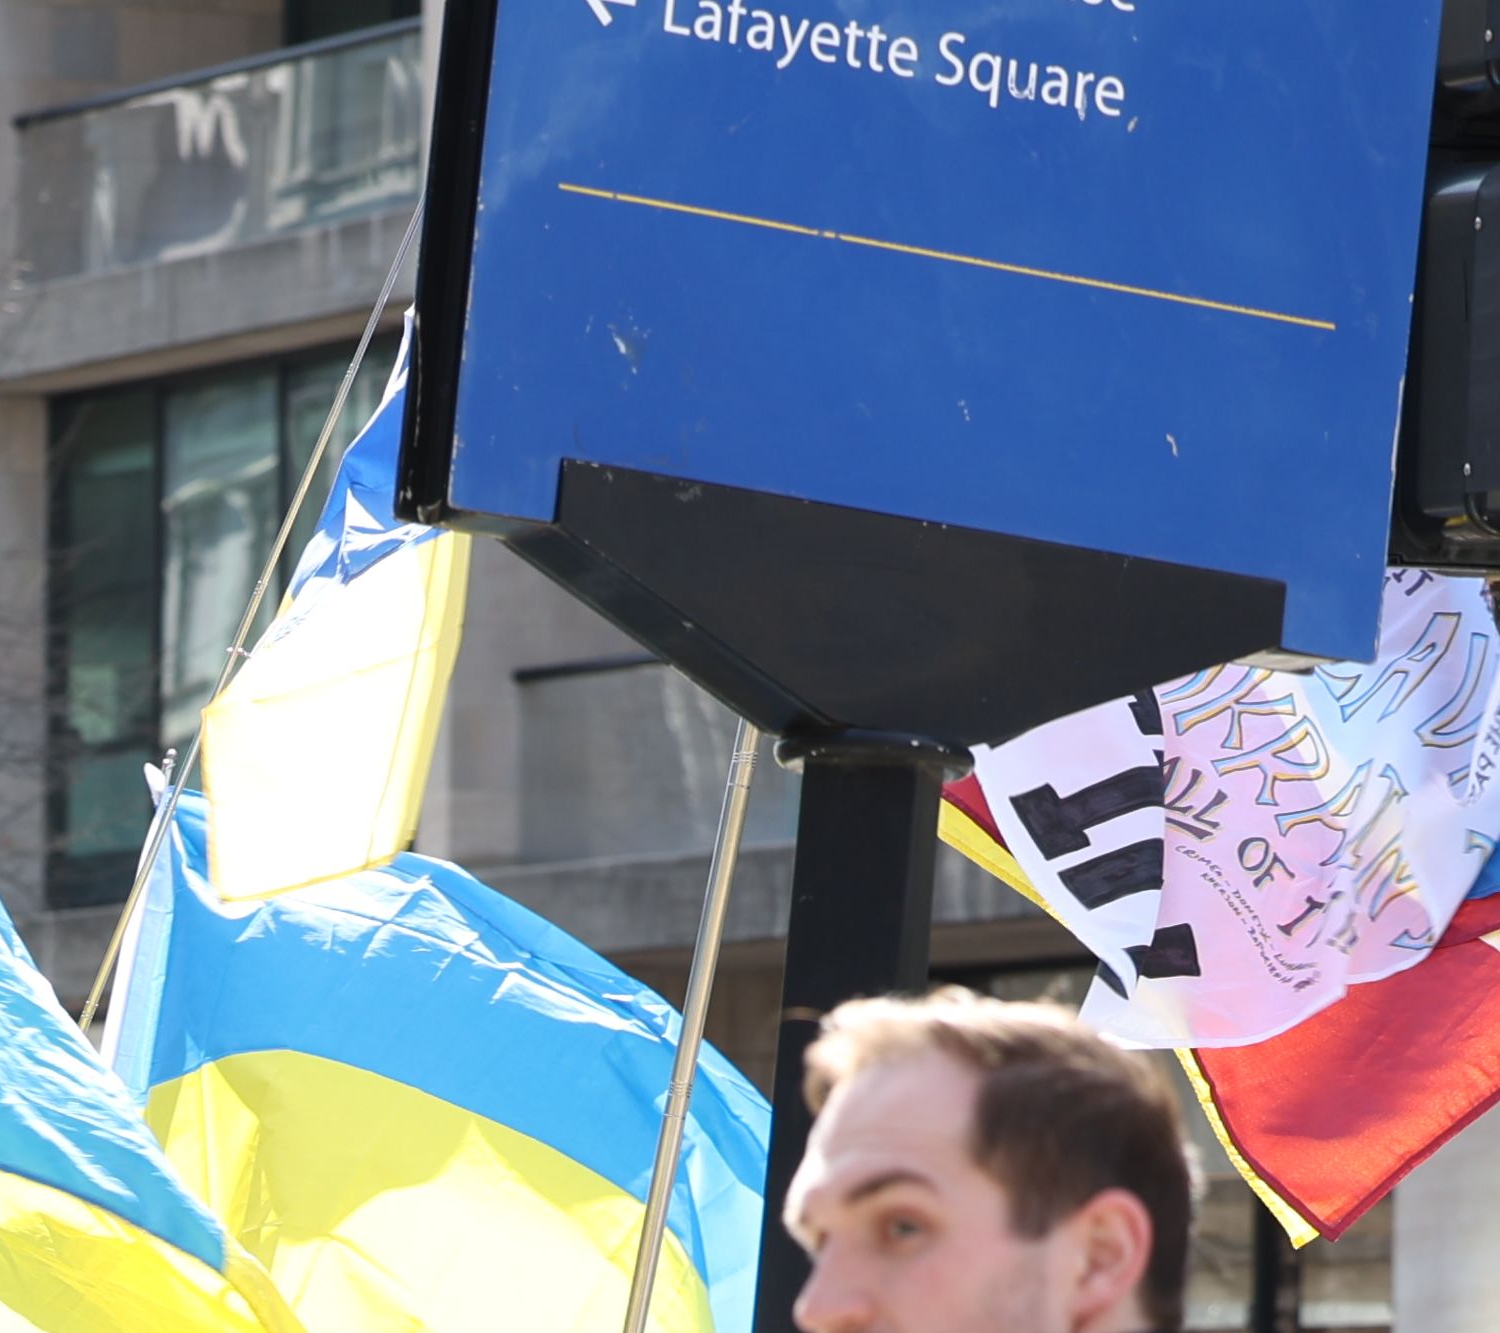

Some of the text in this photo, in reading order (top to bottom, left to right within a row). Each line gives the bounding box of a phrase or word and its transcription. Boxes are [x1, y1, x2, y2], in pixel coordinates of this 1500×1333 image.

[662, 0, 1126, 118] Lafayette Square
[1237, 836, 1296, 889] OF
